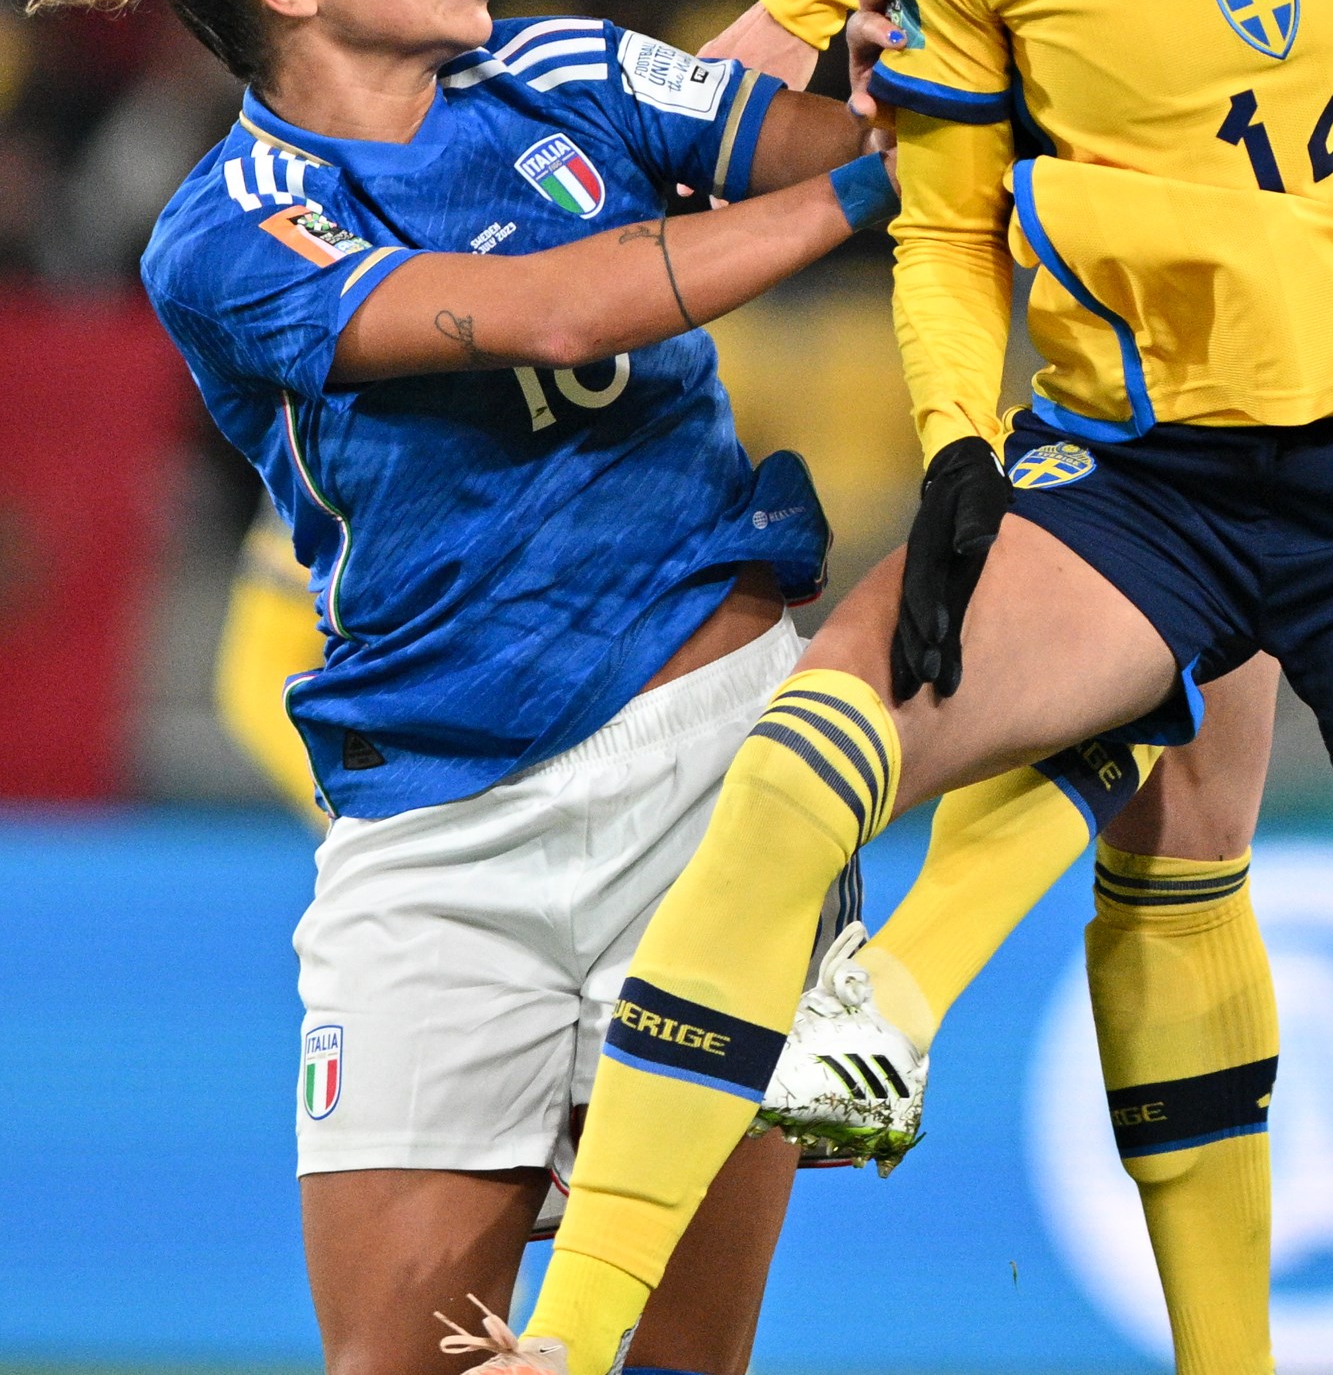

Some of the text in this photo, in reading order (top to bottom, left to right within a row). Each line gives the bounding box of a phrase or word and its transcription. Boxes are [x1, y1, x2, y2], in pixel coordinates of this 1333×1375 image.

[522, 139, 572, 177] ITALIA
[470, 222, 502, 249] SWEDEN
[495, 222, 517, 242] 2023
[307, 1032, 339, 1054] ITALIA
